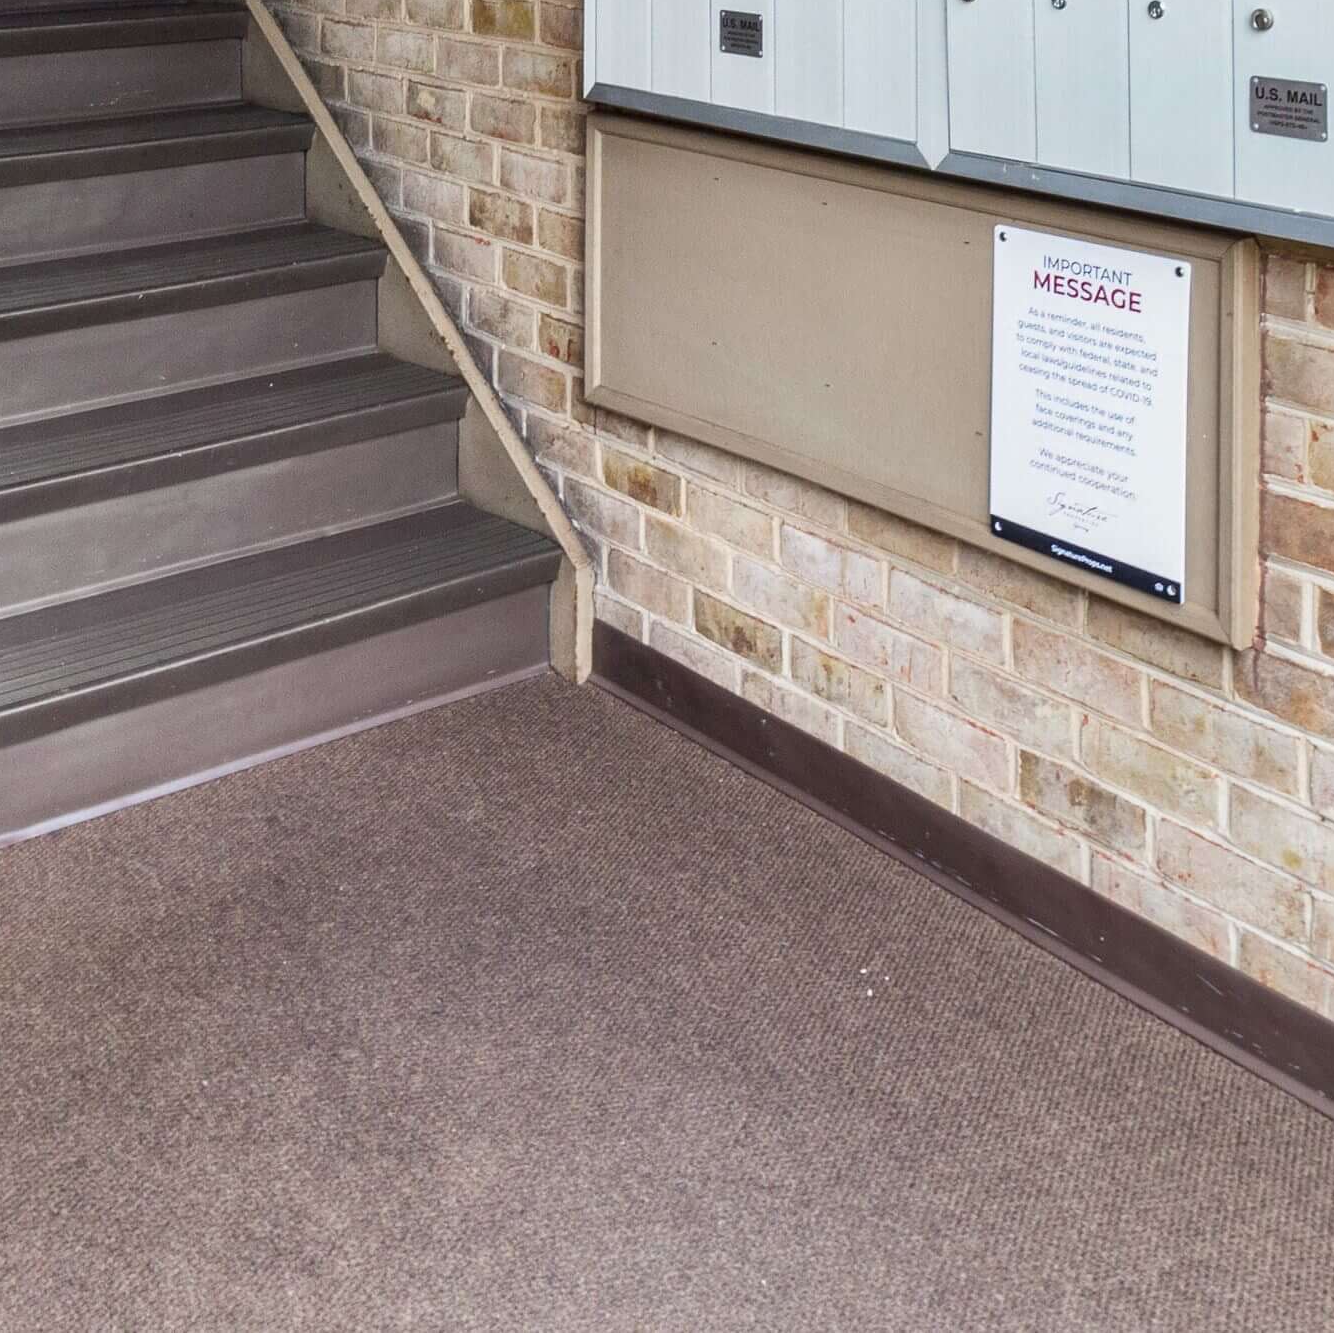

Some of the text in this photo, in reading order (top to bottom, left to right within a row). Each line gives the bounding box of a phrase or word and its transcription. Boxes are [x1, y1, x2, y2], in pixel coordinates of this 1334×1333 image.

[1255, 86, 1323, 107] U.S. MAIL
[1042, 255, 1133, 286] IMPORTANT
[1033, 270, 1142, 313] MESSAGE
[1028, 306, 1038, 317] As
[1090, 322, 1101, 331] all
[1016, 332, 1024, 342] to
[1027, 336, 1056, 352] comply
[1059, 345, 1077, 355] with
[1140, 366, 1158, 378] and
[1049, 327, 1065, 338] and
[1067, 331, 1096, 347] visitors
[1099, 340, 1112, 349] are
[1115, 344, 1157, 361] expected
[1019, 363, 1051, 379] ceasing
[1052, 371, 1066, 381] the
[1068, 377, 1098, 391] spread
[1099, 385, 1108, 394] of
[1021, 348, 1040, 360] local
[1109, 373, 1140, 387] related
[1142, 380, 1152, 391] to
[1035, 388, 1135, 425] This includes the use of
[1035, 403, 1133, 442] face coverings and any
[1032, 419, 1073, 437] additional
[1030, 458, 1076, 481] continued
[1040, 447, 1128, 483] We appreciate your
